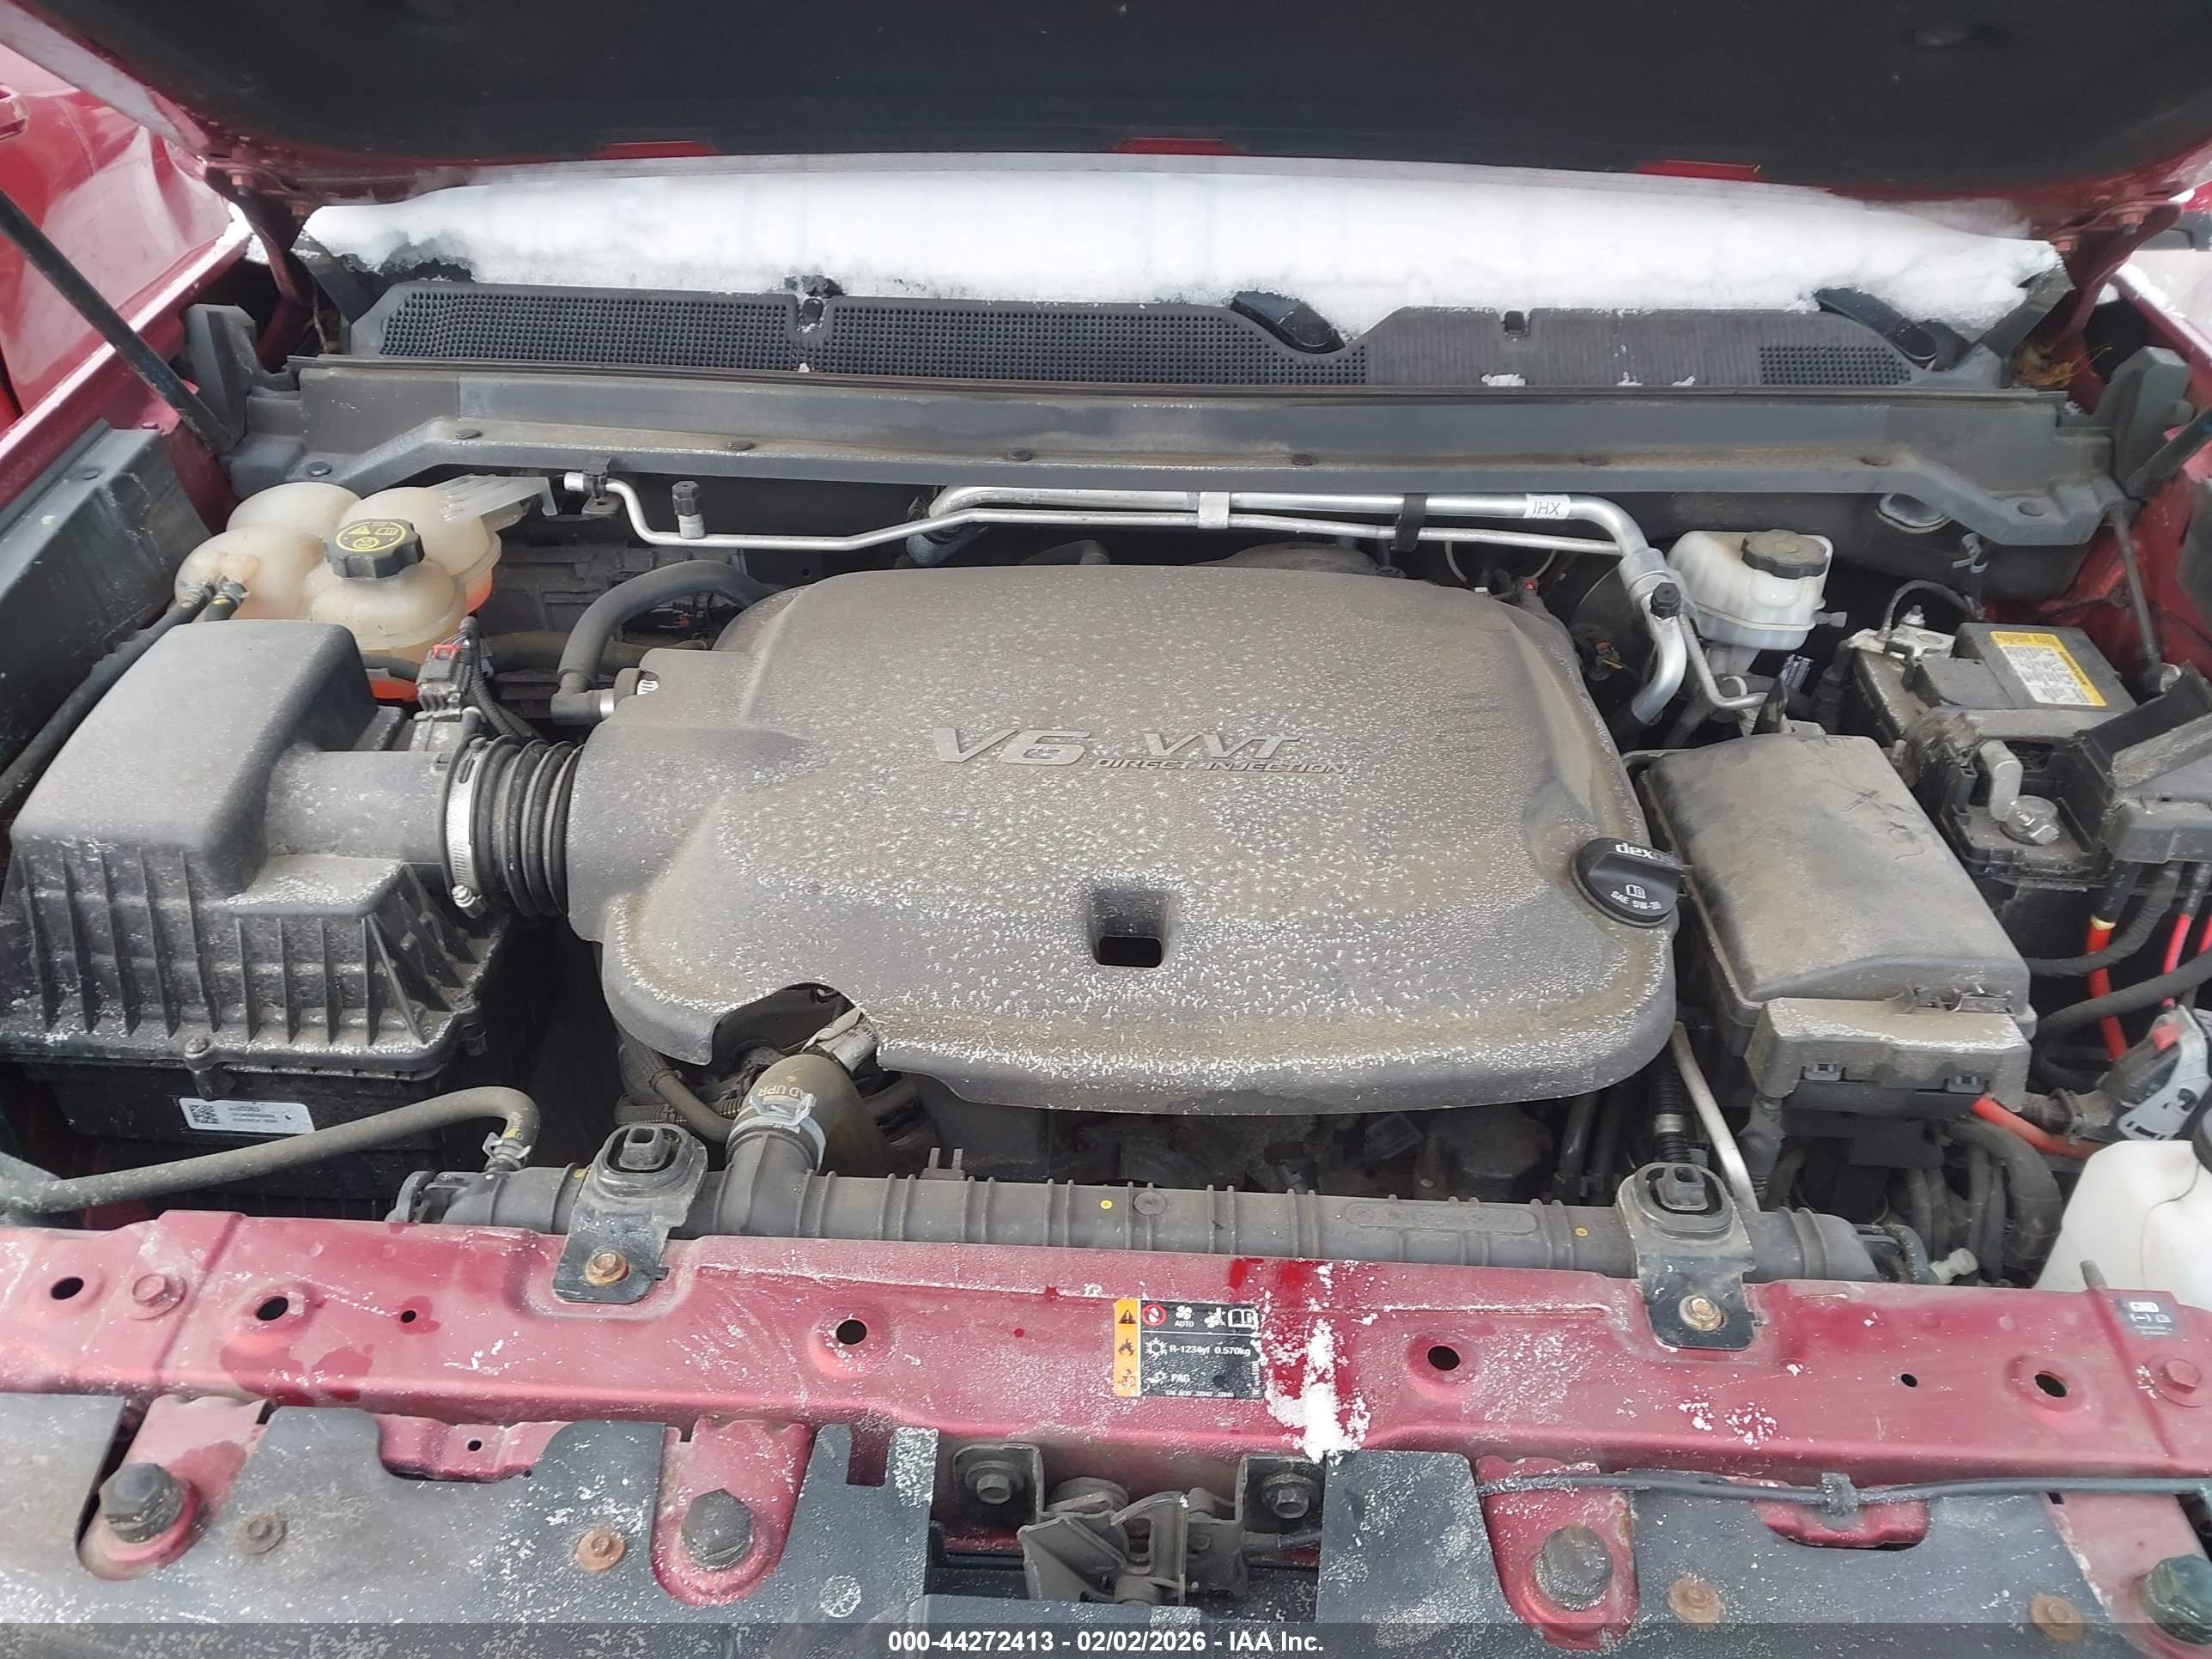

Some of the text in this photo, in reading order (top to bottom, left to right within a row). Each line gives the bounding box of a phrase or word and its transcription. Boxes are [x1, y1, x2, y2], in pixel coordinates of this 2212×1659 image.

[933, 726, 1299, 765] V6 VVT
[1097, 759, 1344, 774] DIRECT INJECTION
[1611, 890, 1630, 905] SAE
[1169, 1344, 1251, 1357] R-1234yf 0.570kg
[1170, 1373, 1191, 1382] PAG
